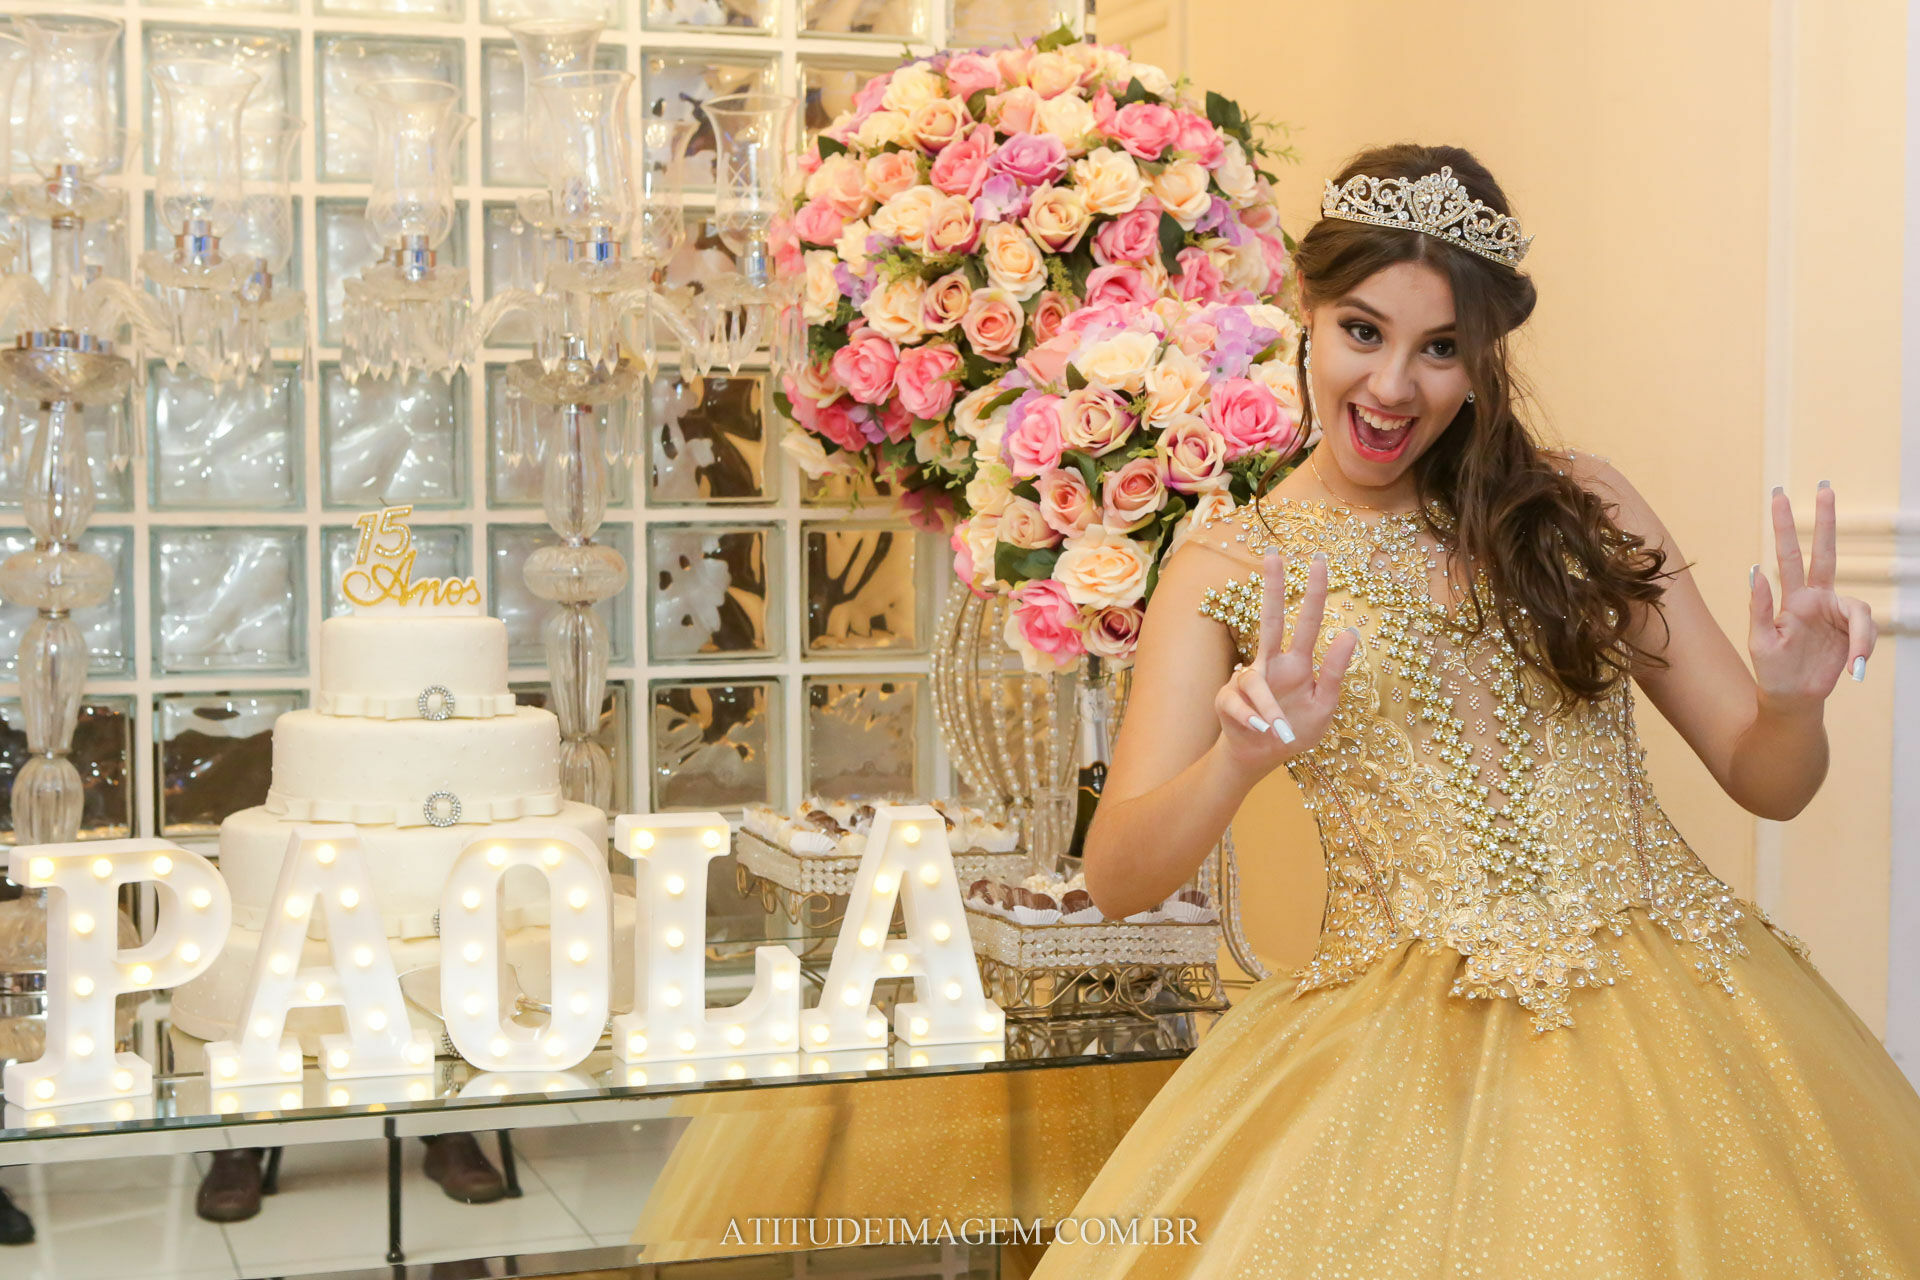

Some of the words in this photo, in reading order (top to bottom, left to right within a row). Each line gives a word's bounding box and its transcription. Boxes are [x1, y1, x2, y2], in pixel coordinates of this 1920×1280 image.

[355, 506, 412, 565] 15
[343, 550, 481, 606] Anos
[4, 804, 1006, 1109] PAOLA
